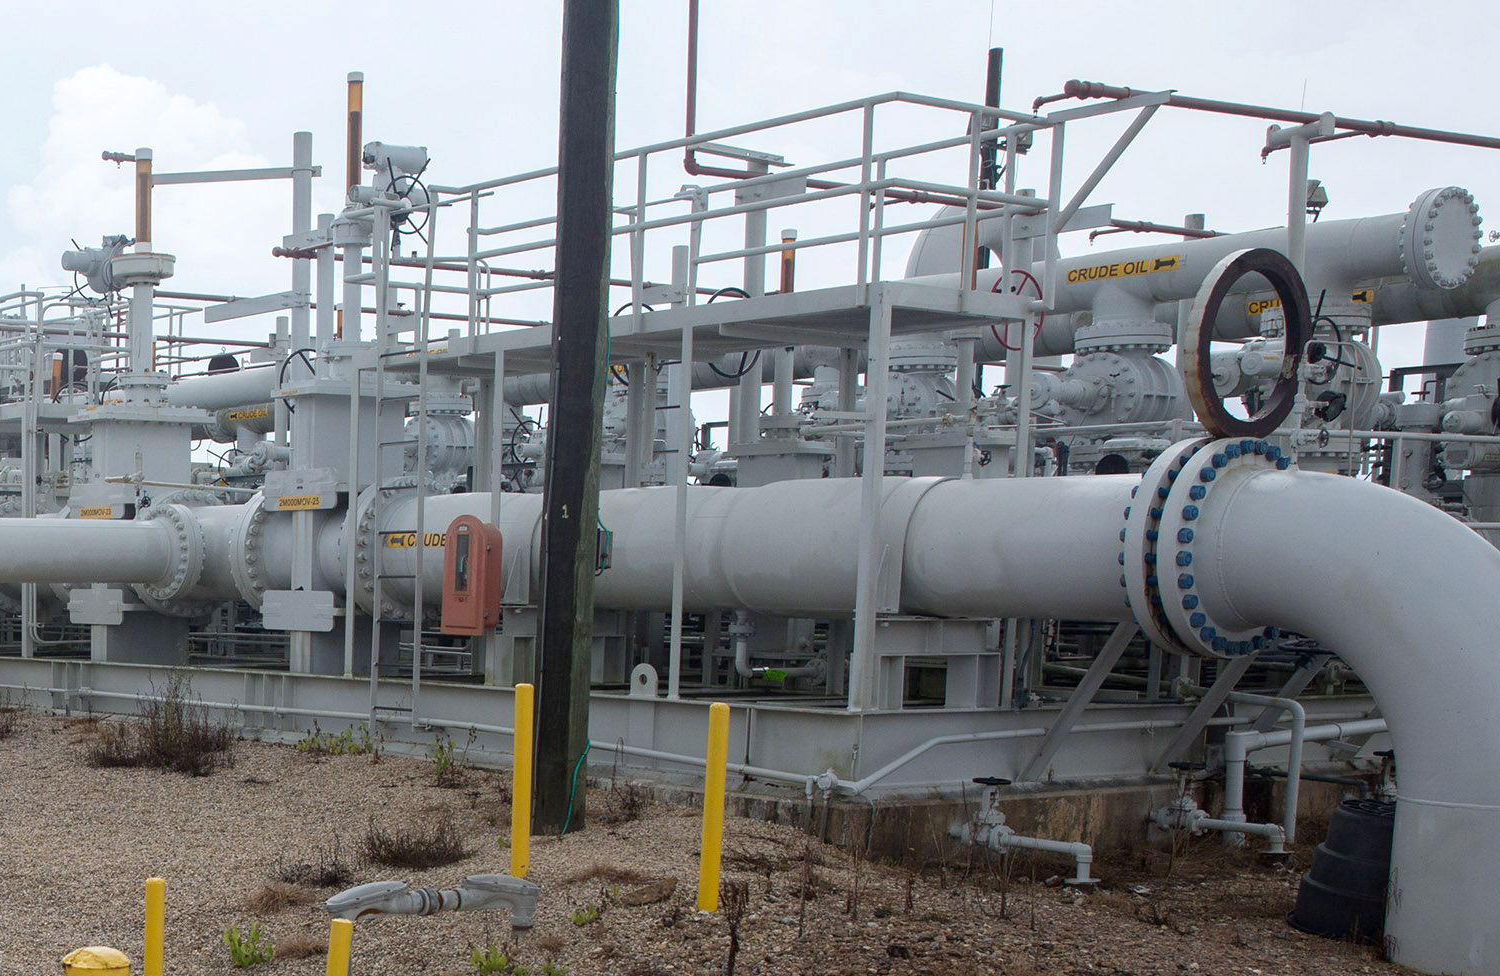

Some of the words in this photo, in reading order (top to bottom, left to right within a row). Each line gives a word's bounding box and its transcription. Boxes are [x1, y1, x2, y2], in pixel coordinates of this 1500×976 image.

[1067, 263, 1119, 282] CRUDE
[1123, 260, 1148, 275] OIL
[407, 533, 446, 547] CUDE
